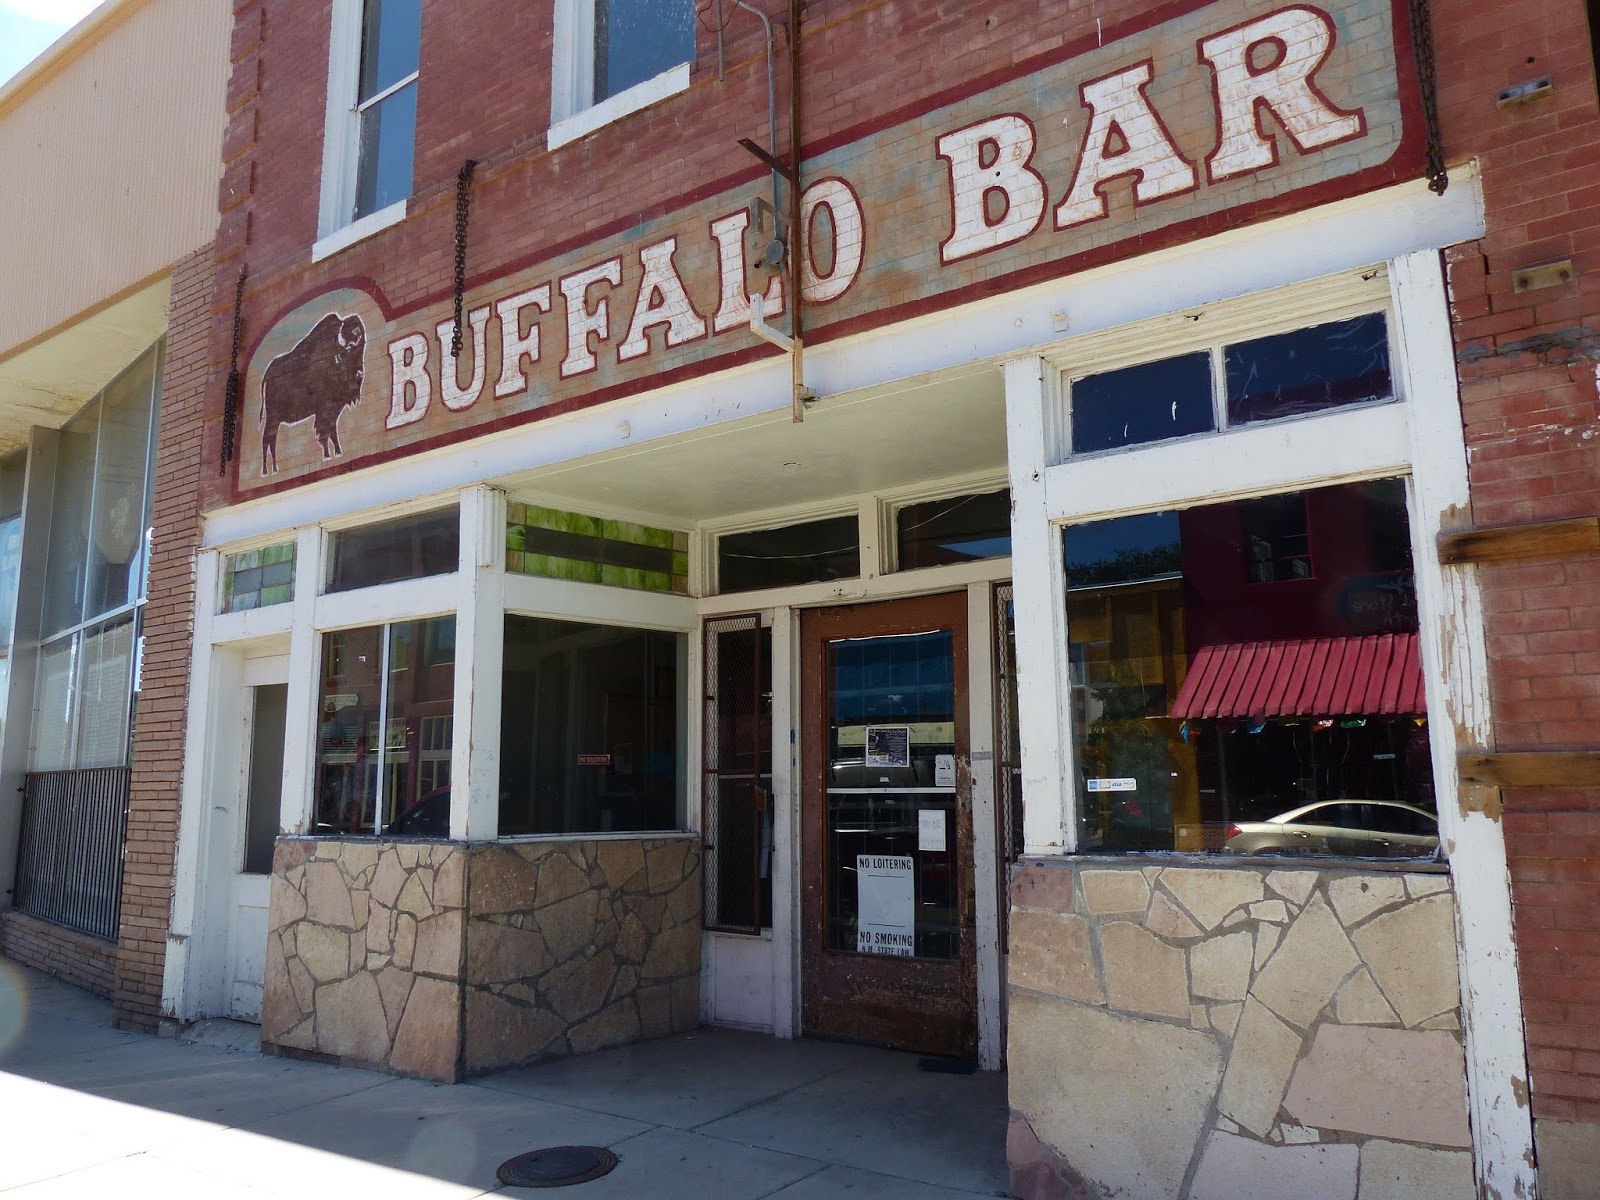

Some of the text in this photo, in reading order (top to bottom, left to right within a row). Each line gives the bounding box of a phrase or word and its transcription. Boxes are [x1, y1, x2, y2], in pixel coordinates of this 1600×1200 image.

[386, 4, 1367, 430] BUFFALO BAR
[859, 857, 912, 870] NO LOITERING
[860, 931, 913, 947] NO SMOKING
[877, 946, 895, 956] STATE
[897, 948, 910, 957] LAW
